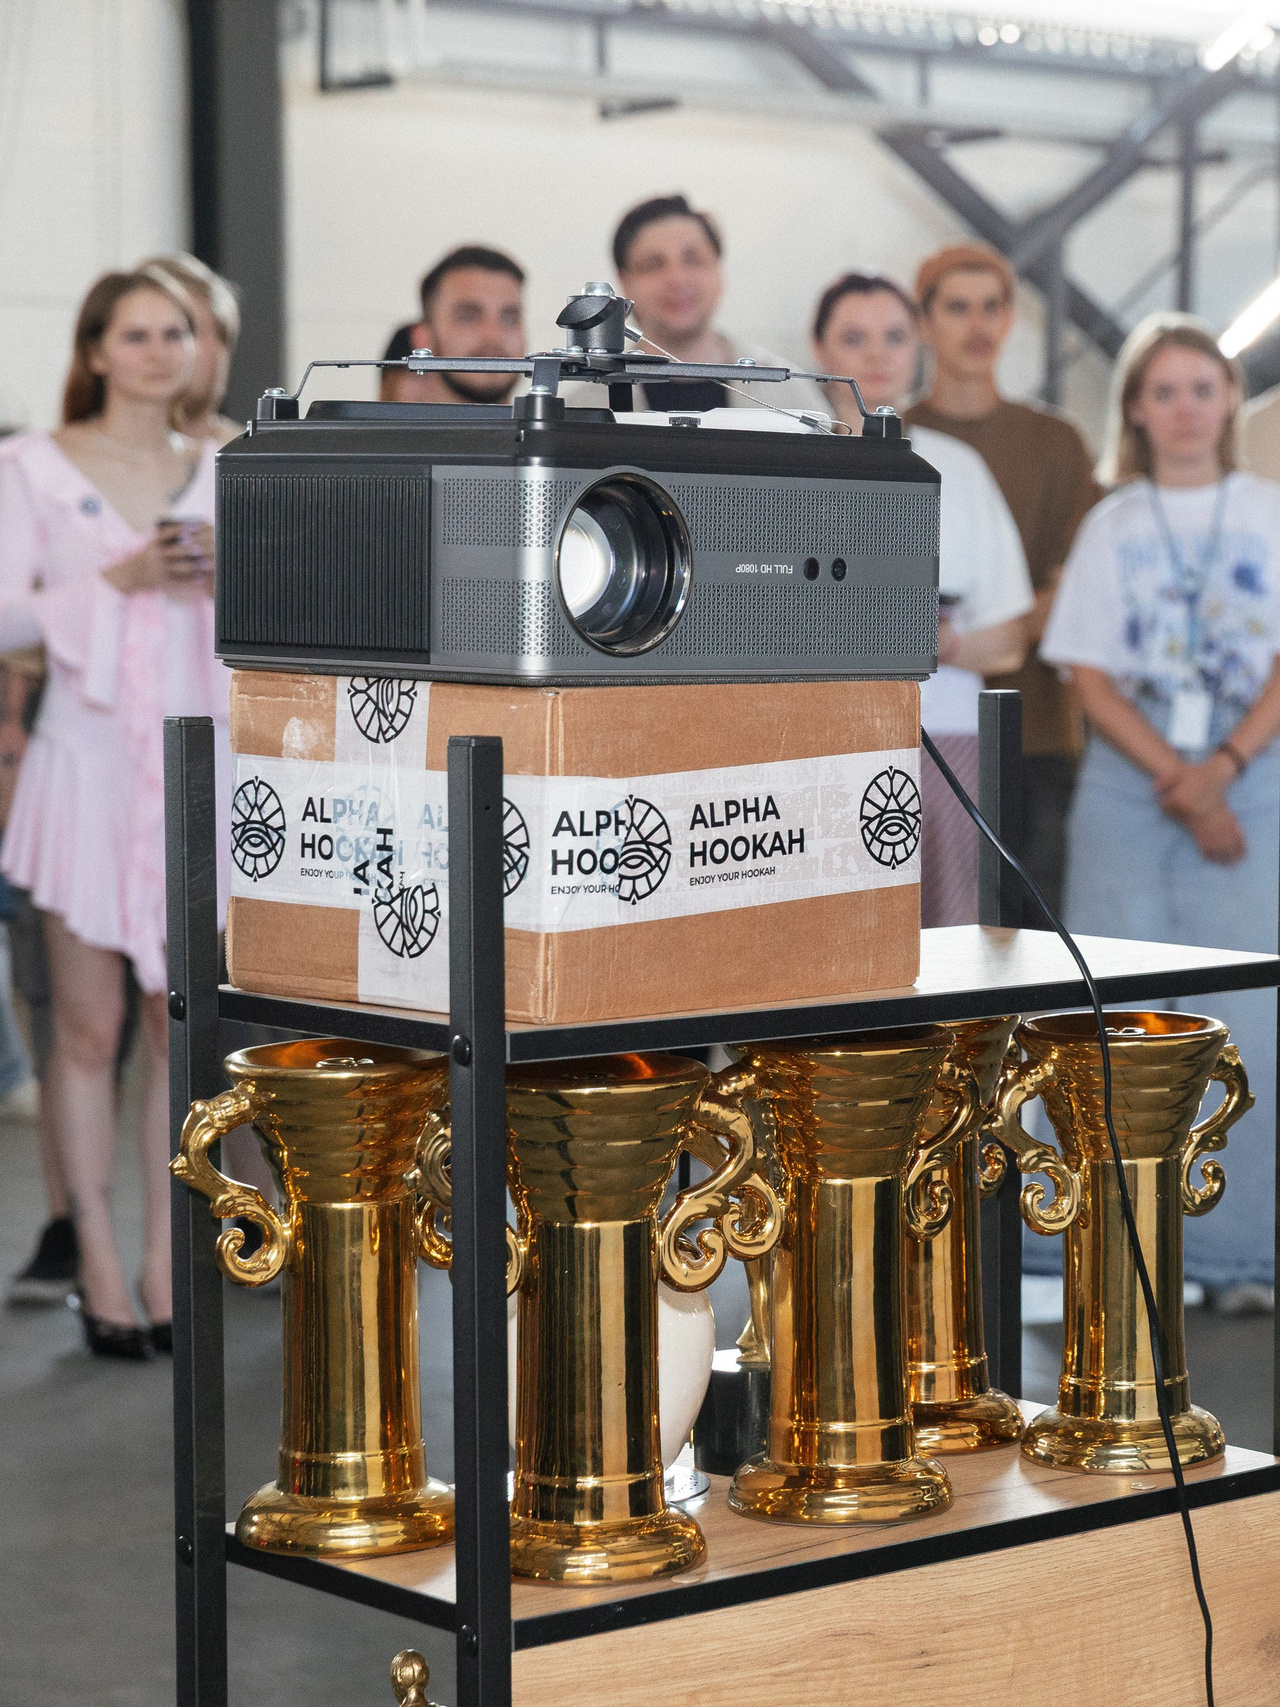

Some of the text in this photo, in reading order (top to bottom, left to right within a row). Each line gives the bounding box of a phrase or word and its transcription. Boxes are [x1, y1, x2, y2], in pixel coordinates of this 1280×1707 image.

[735, 563, 794, 574] FULL HD 1080P
[690, 795, 780, 830] ALPHA
[689, 827, 805, 867] HOOKAH
[300, 868, 323, 877] ENJOY
[689, 866, 776, 886] ENJOY YOUR HOOKAH
[551, 883, 582, 895] ENJOY
[582, 882, 608, 894] YOUR
